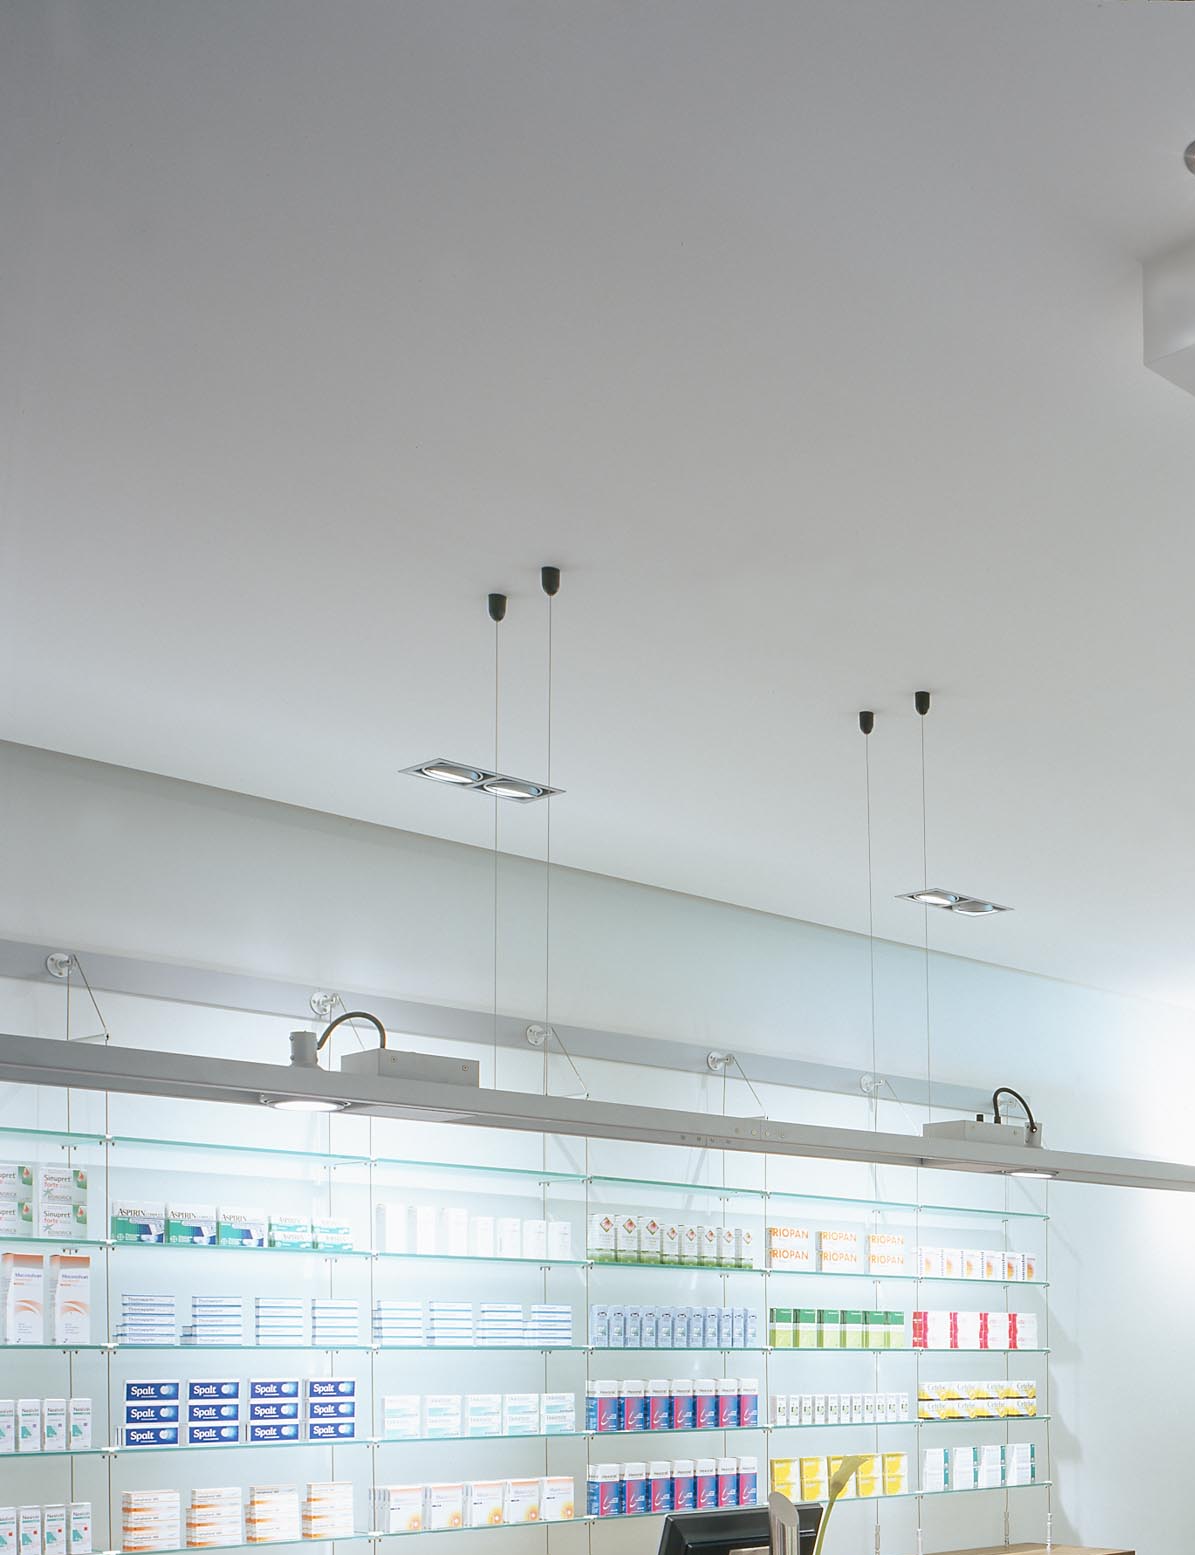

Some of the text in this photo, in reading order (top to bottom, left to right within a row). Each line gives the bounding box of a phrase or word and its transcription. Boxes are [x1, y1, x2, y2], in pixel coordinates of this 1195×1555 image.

[43, 1174, 72, 1184] Sinupret
[43, 1210, 71, 1219] Sinupret
[119, 1208, 146, 1217] ASPIRIN
[170, 1210, 197, 1219] ASPIRIN
[222, 1213, 248, 1222] ASPIRIN
[771, 1227, 809, 1239] RIOPAN
[821, 1231, 857, 1242] RIOPAN
[870, 1235, 904, 1245] RIOPAN
[771, 1249, 809, 1260] RIOPAN
[821, 1252, 857, 1263] RIOPAN
[870, 1255, 904, 1265] RIOPAN
[131, 1386, 155, 1397] Spalt
[193, 1385, 217, 1396] Spalt
[254, 1384, 277, 1395] Spalt
[313, 1383, 335, 1395] Spalt
[131, 1408, 155, 1420] Spalt
[193, 1407, 217, 1419] Spalt
[254, 1405, 277, 1417] Spalt
[313, 1404, 335, 1416] Spalt
[130, 1430, 154, 1442] Spalt
[193, 1429, 217, 1440] Spalt
[254, 1426, 277, 1438] Spalt
[313, 1425, 335, 1437] Spalt
